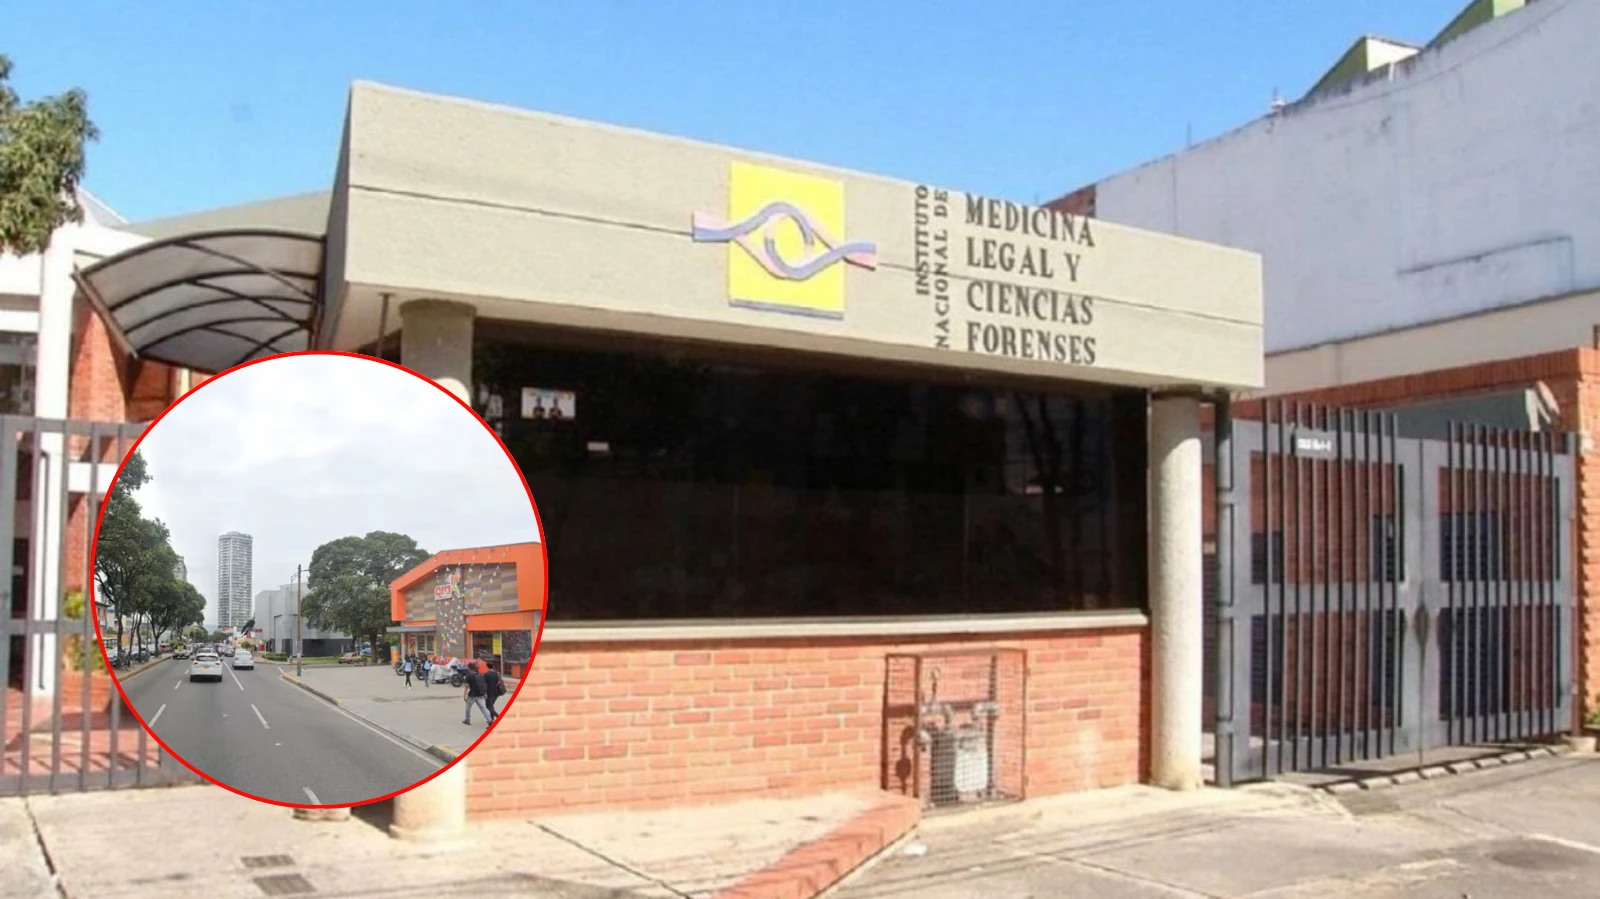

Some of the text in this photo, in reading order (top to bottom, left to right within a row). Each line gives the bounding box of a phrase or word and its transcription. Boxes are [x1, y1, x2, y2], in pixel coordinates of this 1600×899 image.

[915, 185, 930, 295] INSTITUTO
[965, 192, 1095, 248] MEDICINA
[934, 189, 949, 349] NACIONAL DE
[966, 236, 1081, 282] LEGAL Y
[967, 280, 1094, 326] CIENCIAS
[966, 320, 1096, 365] FORENSES
